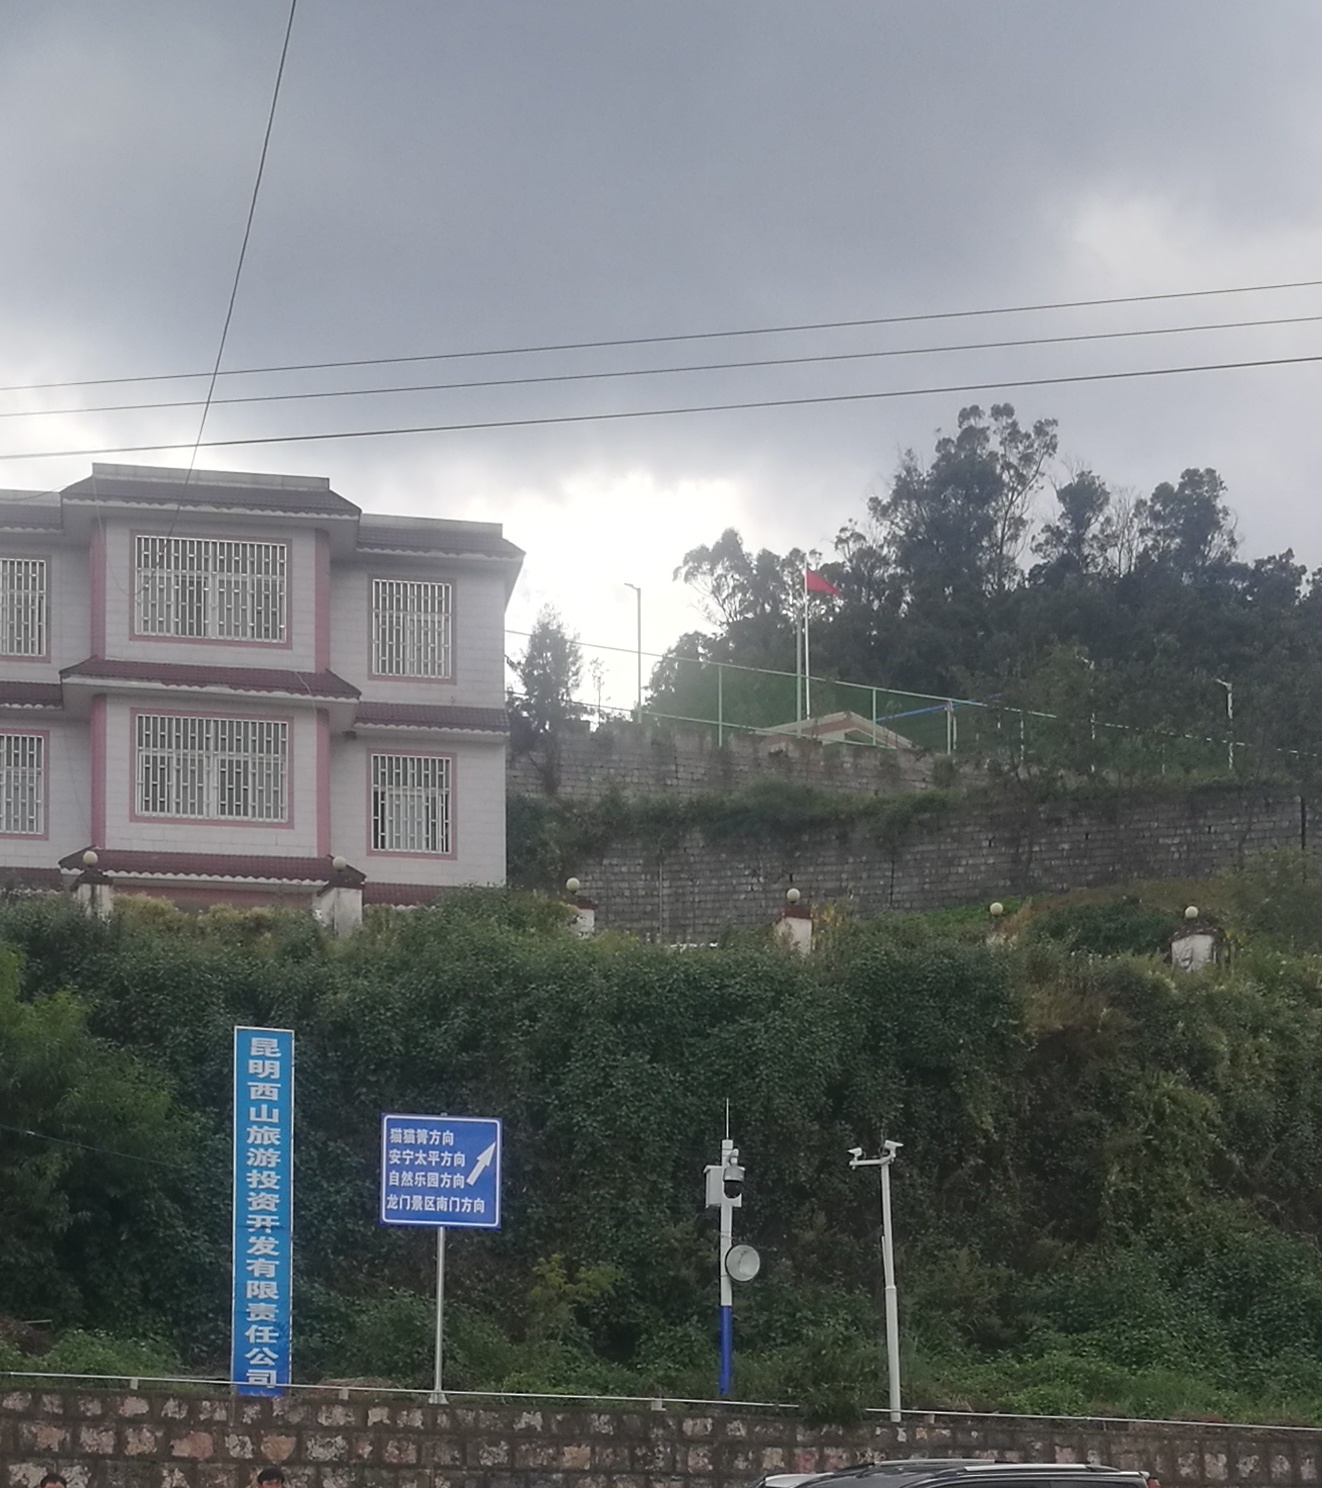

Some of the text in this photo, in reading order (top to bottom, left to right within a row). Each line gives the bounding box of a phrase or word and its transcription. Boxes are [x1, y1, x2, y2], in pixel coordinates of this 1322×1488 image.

[389, 1127, 454, 1146] 猫猫箐方向
[388, 1148, 465, 1167] 安宁太平方向
[388, 1169, 465, 1189] 自然乐园方向
[244, 1037, 282, 1389] 昆明西山旅游投资开发有限责任公司
[386, 1193, 485, 1213] 龙门景区南门方向
